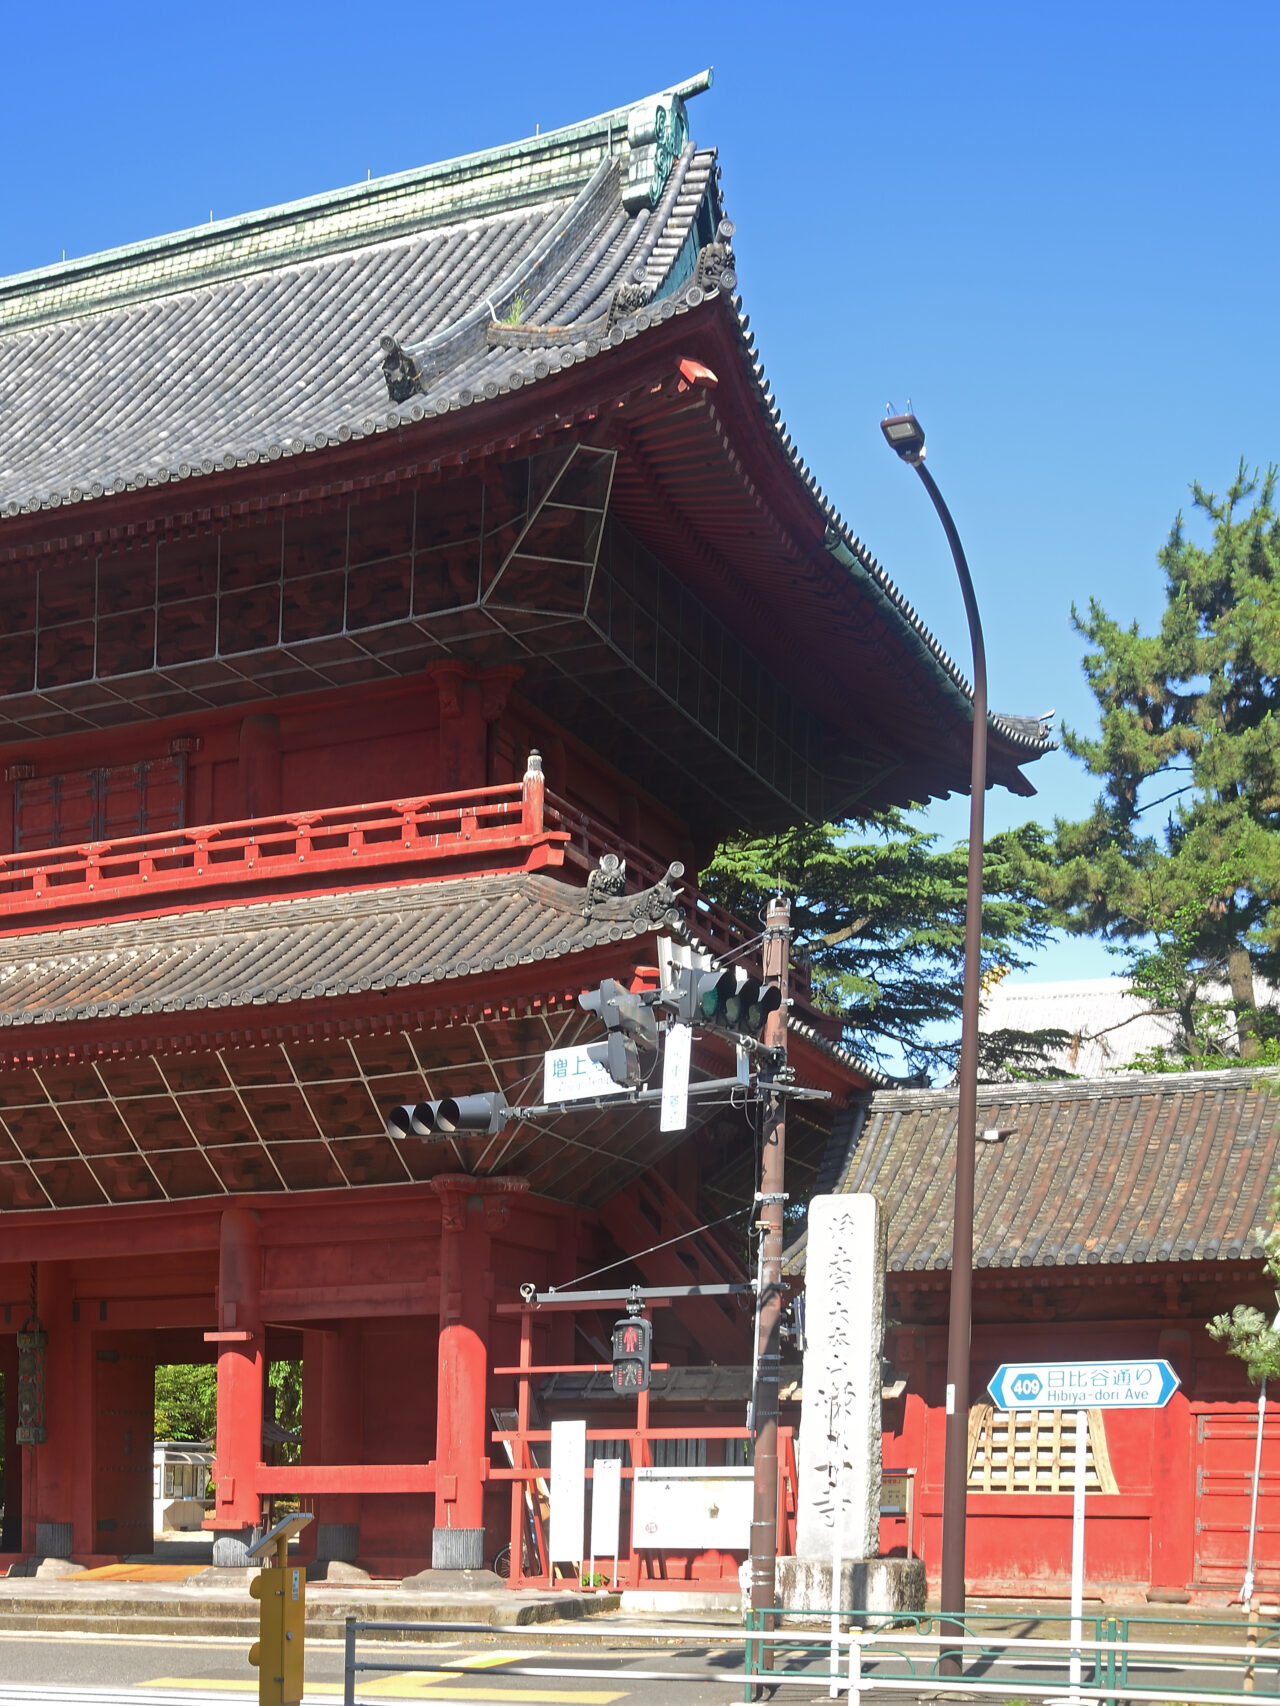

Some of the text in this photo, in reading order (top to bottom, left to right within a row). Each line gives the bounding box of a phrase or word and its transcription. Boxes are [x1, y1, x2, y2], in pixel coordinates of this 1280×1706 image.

[1013, 1368, 1153, 1395] 409 日比谷通り
[1047, 1387, 1149, 1404] Hibiya-dori Ave
